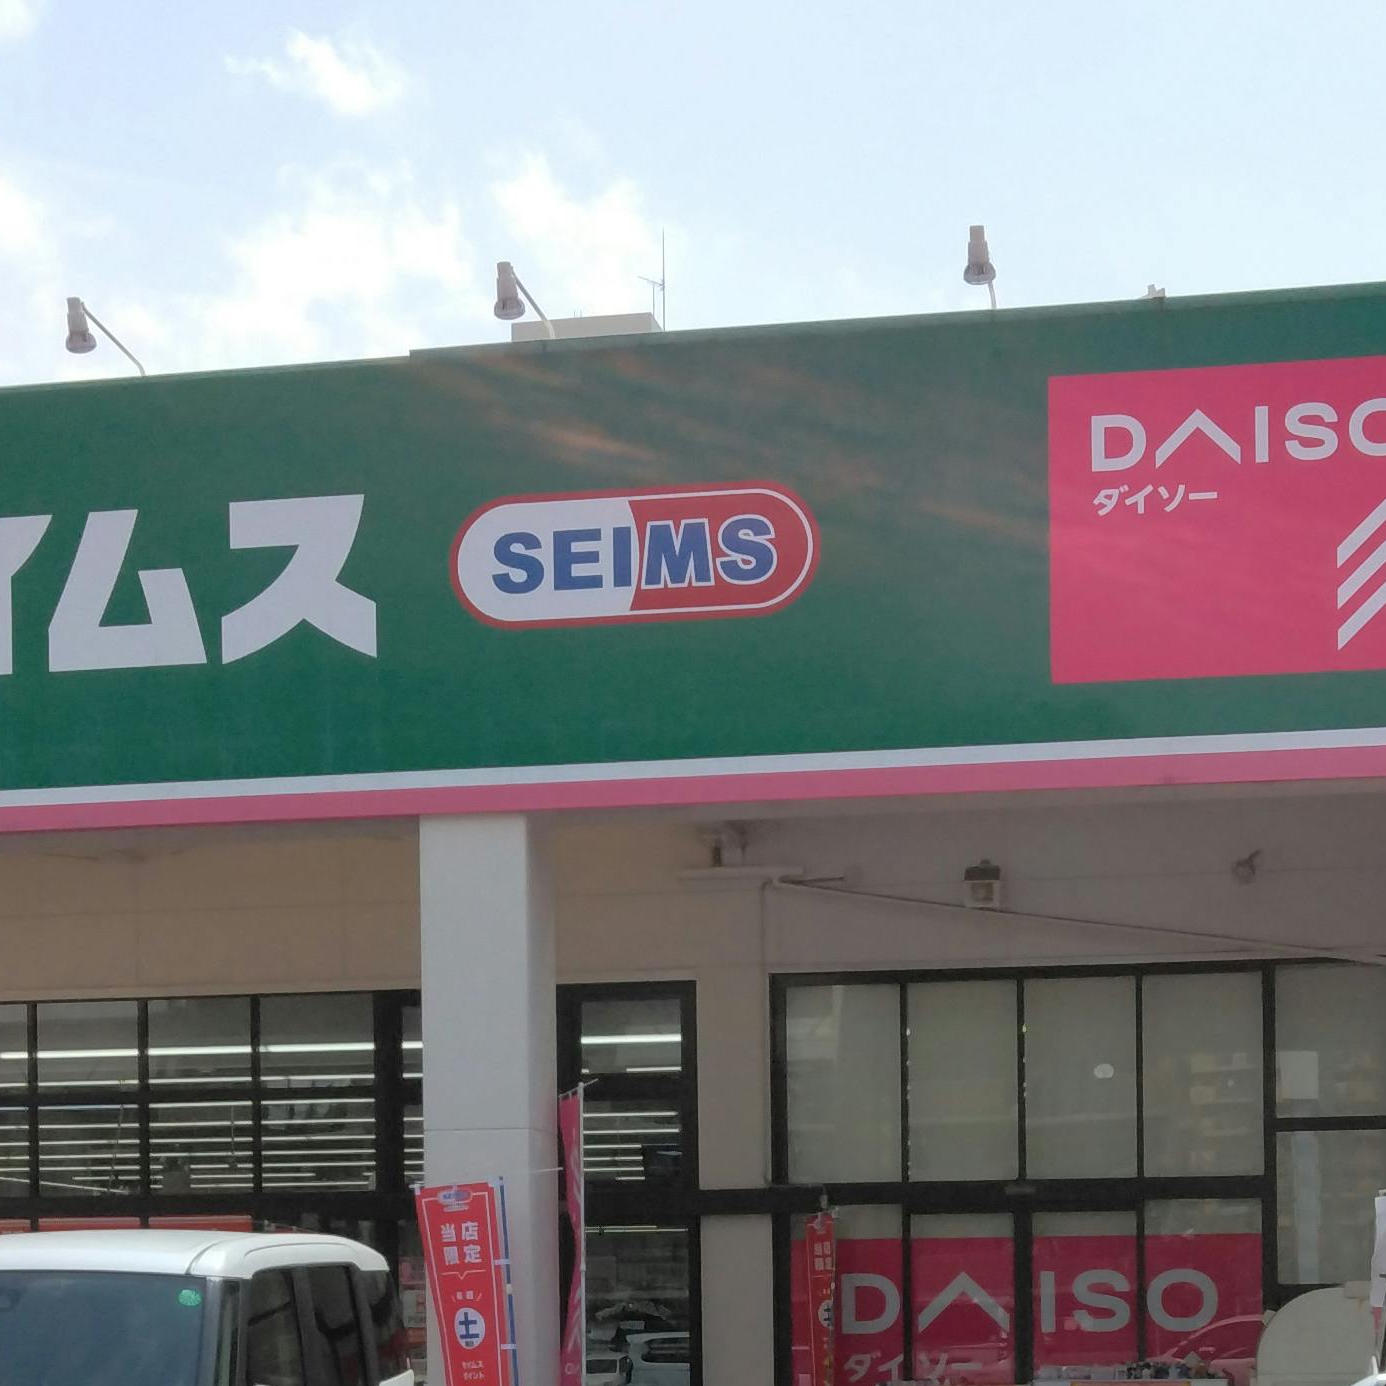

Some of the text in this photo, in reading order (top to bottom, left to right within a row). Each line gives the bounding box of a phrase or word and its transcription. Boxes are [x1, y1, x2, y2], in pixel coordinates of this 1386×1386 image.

[1092, 484, 1219, 516] ダイソー
[491, 513, 779, 595] SEIMS
[441, 1221, 479, 1242] 当店
[840, 1267, 1219, 1335] DAISO
[458, 1311, 480, 1339] 土
[843, 1351, 982, 1385] ダイソー
